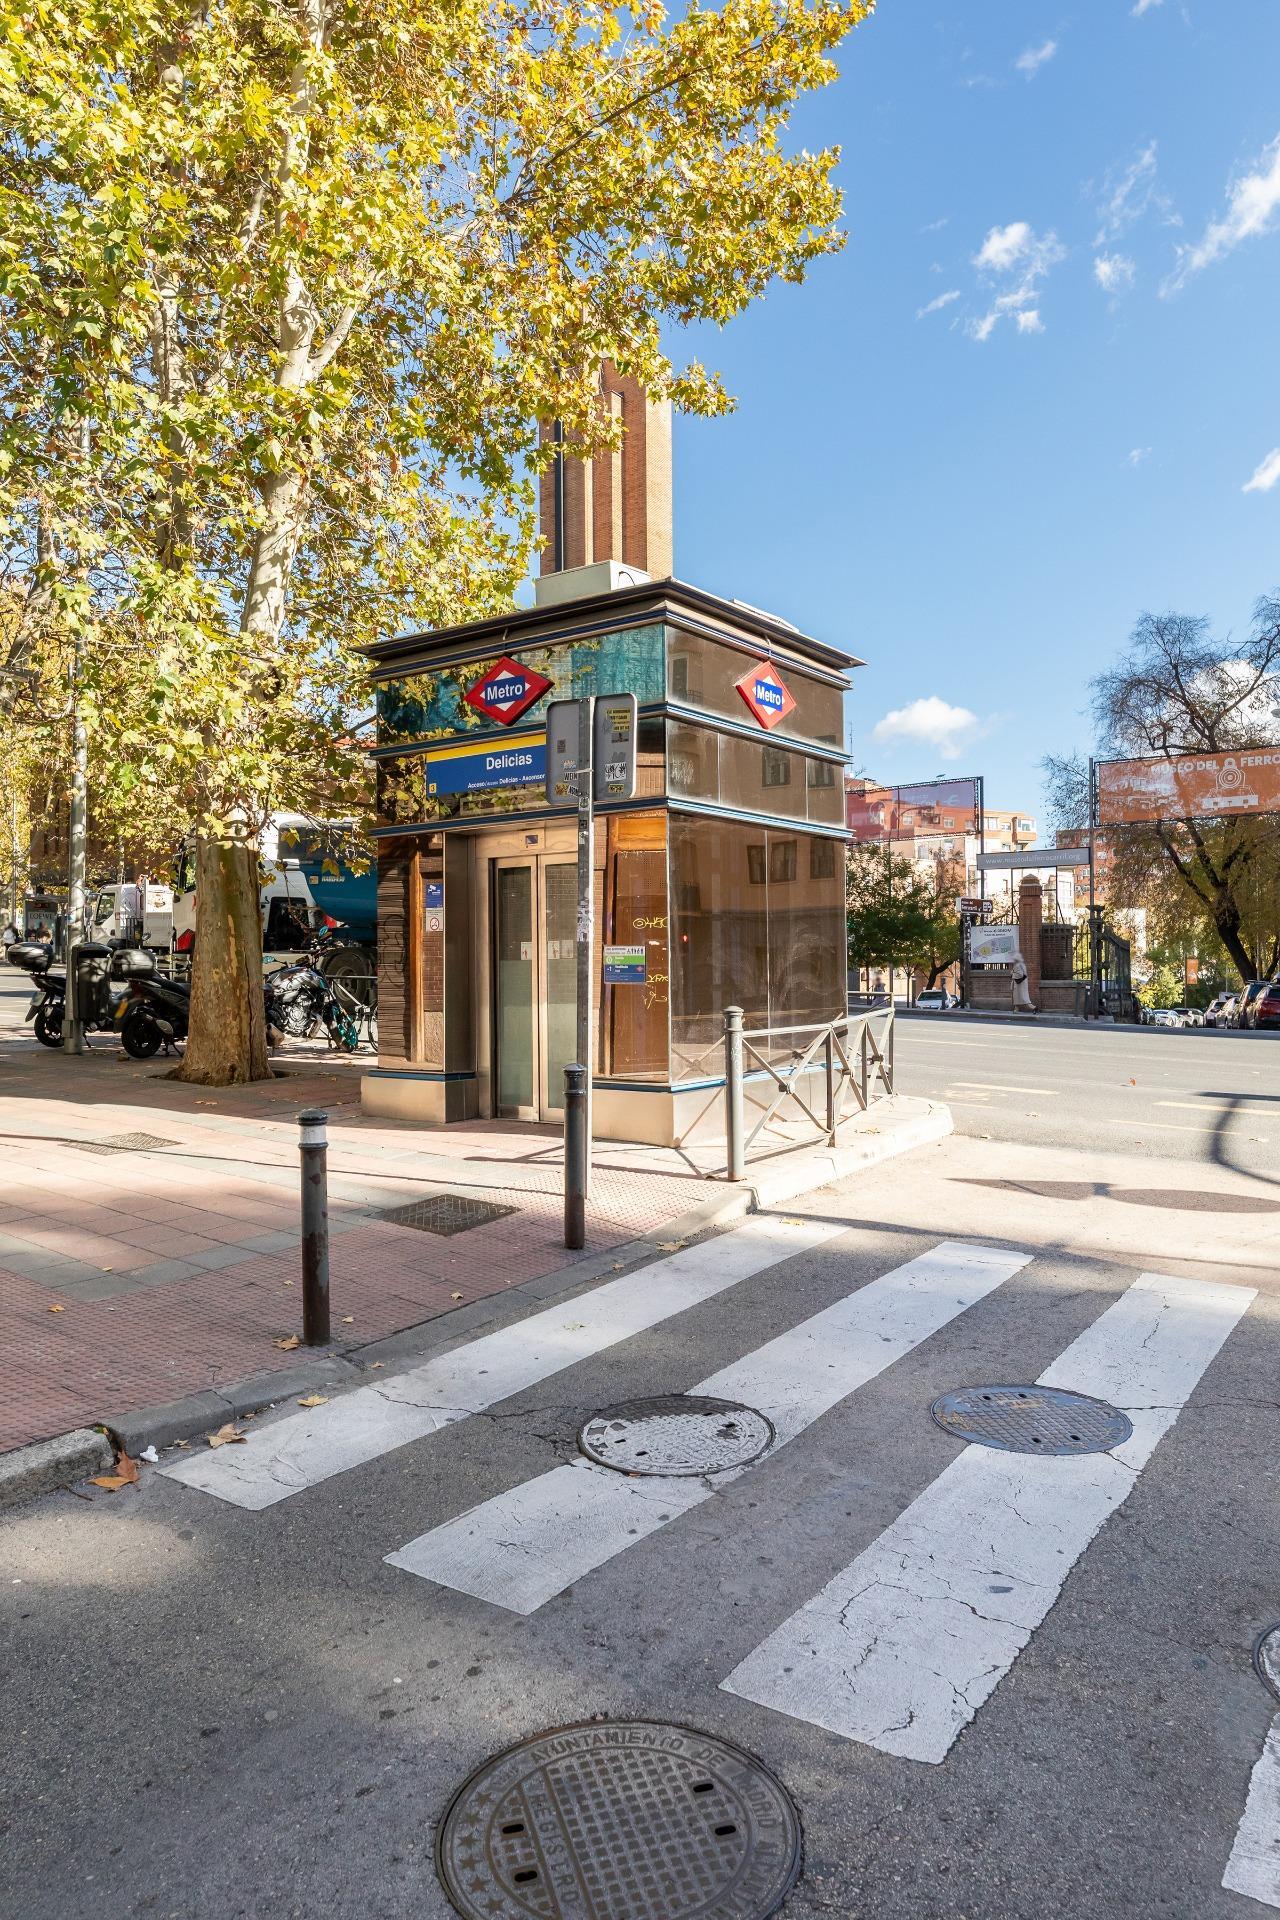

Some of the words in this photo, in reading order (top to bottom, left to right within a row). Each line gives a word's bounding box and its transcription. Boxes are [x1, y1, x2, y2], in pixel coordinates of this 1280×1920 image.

[487, 683, 523, 701] Metro
[756, 685, 781, 706] Metro
[486, 753, 533, 770] Delicias
[1151, 763, 1194, 774] MUSEO
[1197, 760, 1219, 771] DEL
[429, 784, 436, 793] 3
[499, 777, 518, 785] Delicias
[985, 852, 1081, 864] www.museodelferrocarril.org
[29, 912, 53, 920] LOEWE
[530, 1731, 684, 1765] AYUNTAMIENTO
[698, 1747, 726, 1769] DE
[529, 1794, 580, 1904] REGISTRO
